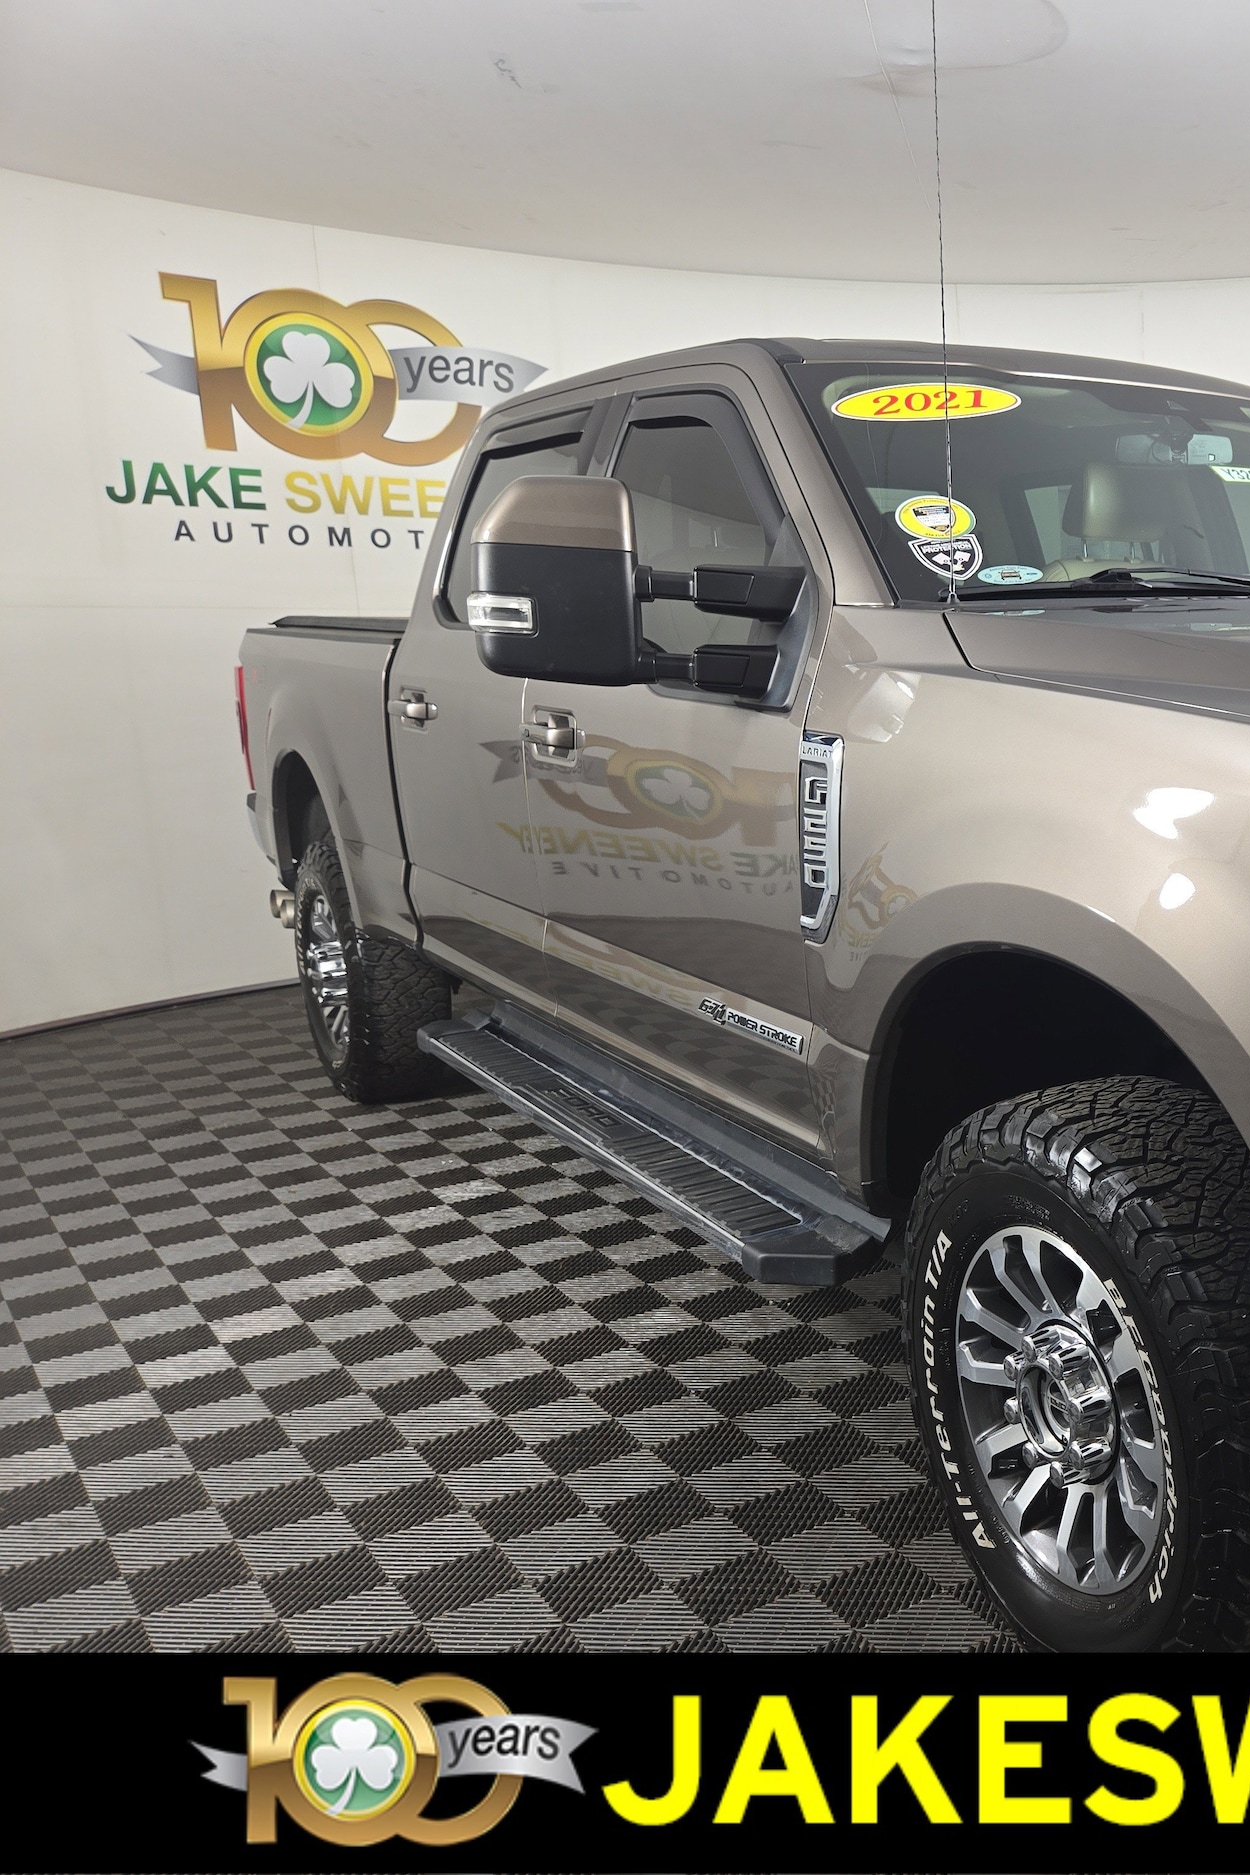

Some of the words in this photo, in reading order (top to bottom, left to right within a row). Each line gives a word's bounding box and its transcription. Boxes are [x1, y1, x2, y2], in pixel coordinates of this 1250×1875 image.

[403, 351, 515, 393] years
[872, 390, 987, 416] 2021
[105, 460, 267, 511] JAKE
[284, 471, 446, 520] SWEE
[174, 519, 424, 550] AUTOMOT
[802, 745, 833, 759] LARIAT
[727, 1011, 759, 1033] POWER
[759, 1024, 798, 1049] STROKE
[924, 1228, 953, 1291] T/A
[921, 1294, 997, 1549] All-Terrain
[1104, 1277, 1179, 1604] BFGoodrich
